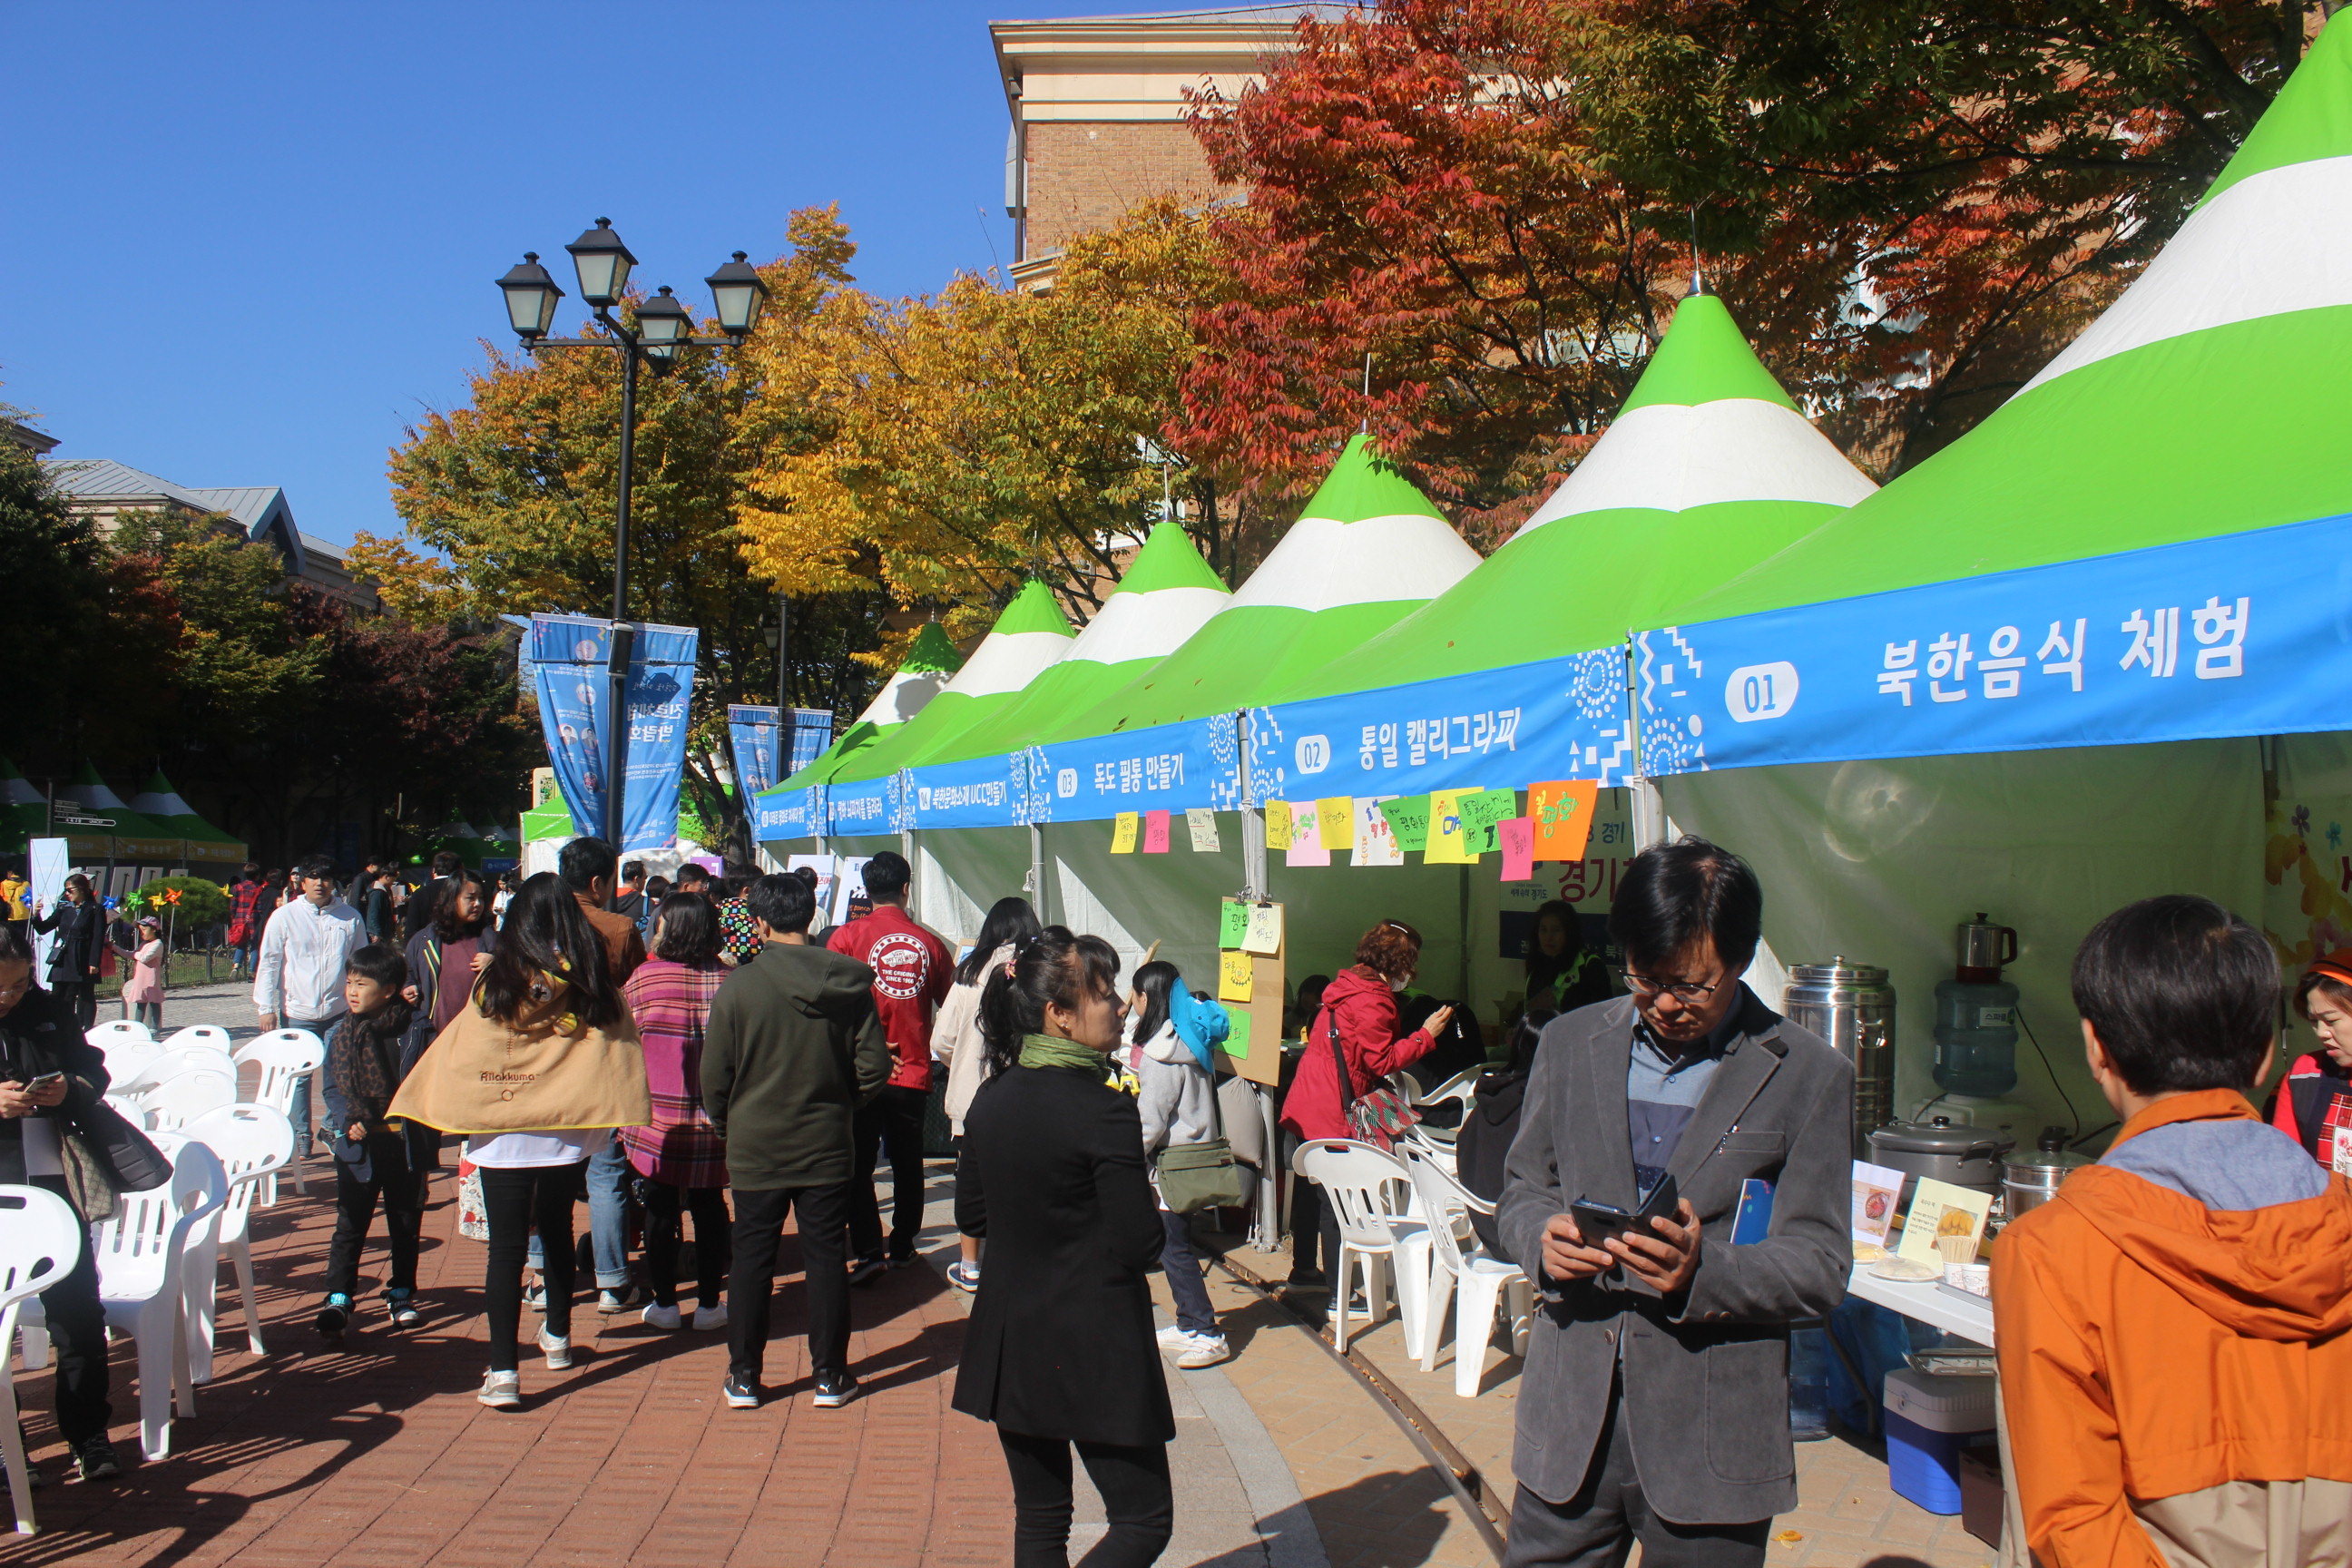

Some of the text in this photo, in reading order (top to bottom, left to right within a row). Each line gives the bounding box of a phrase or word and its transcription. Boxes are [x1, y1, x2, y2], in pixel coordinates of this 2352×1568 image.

[1742, 594, 2251, 715] 01 북한음식 체험
[1304, 707, 1522, 770] 02 통일 캘리그라피
[932, 785, 970, 810] 북한문화소재
[970, 779, 1007, 807] UCC만들기
[1062, 752, 1184, 796] 03 독도 필통 만들기
[1542, 790, 1579, 838] 평화
[1602, 821, 1625, 844] 경기
[1559, 858, 1633, 903] 경기
[1984, 1013, 2006, 1022] 스파클
